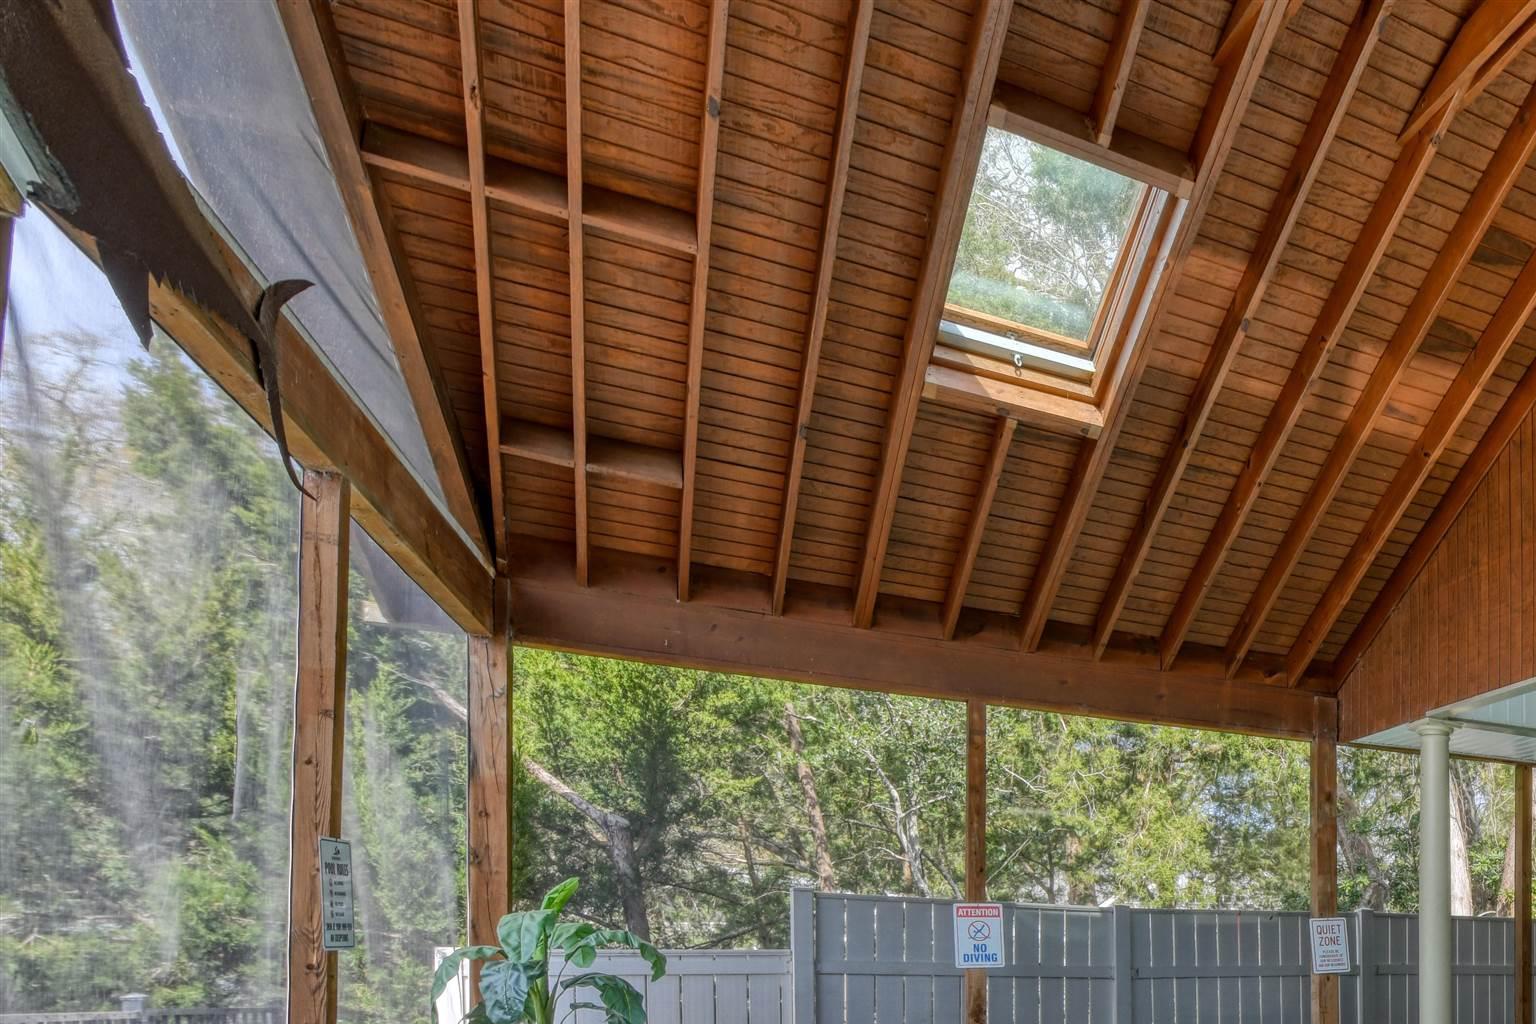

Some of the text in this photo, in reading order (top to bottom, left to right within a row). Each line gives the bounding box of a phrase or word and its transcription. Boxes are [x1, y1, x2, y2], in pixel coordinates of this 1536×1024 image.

[958, 907, 999, 917] ATTENTION
[1316, 924, 1342, 935] QUIET
[1319, 935, 1342, 947] ZONE
[973, 943, 988, 953] NO
[963, 952, 998, 963] DIVING
